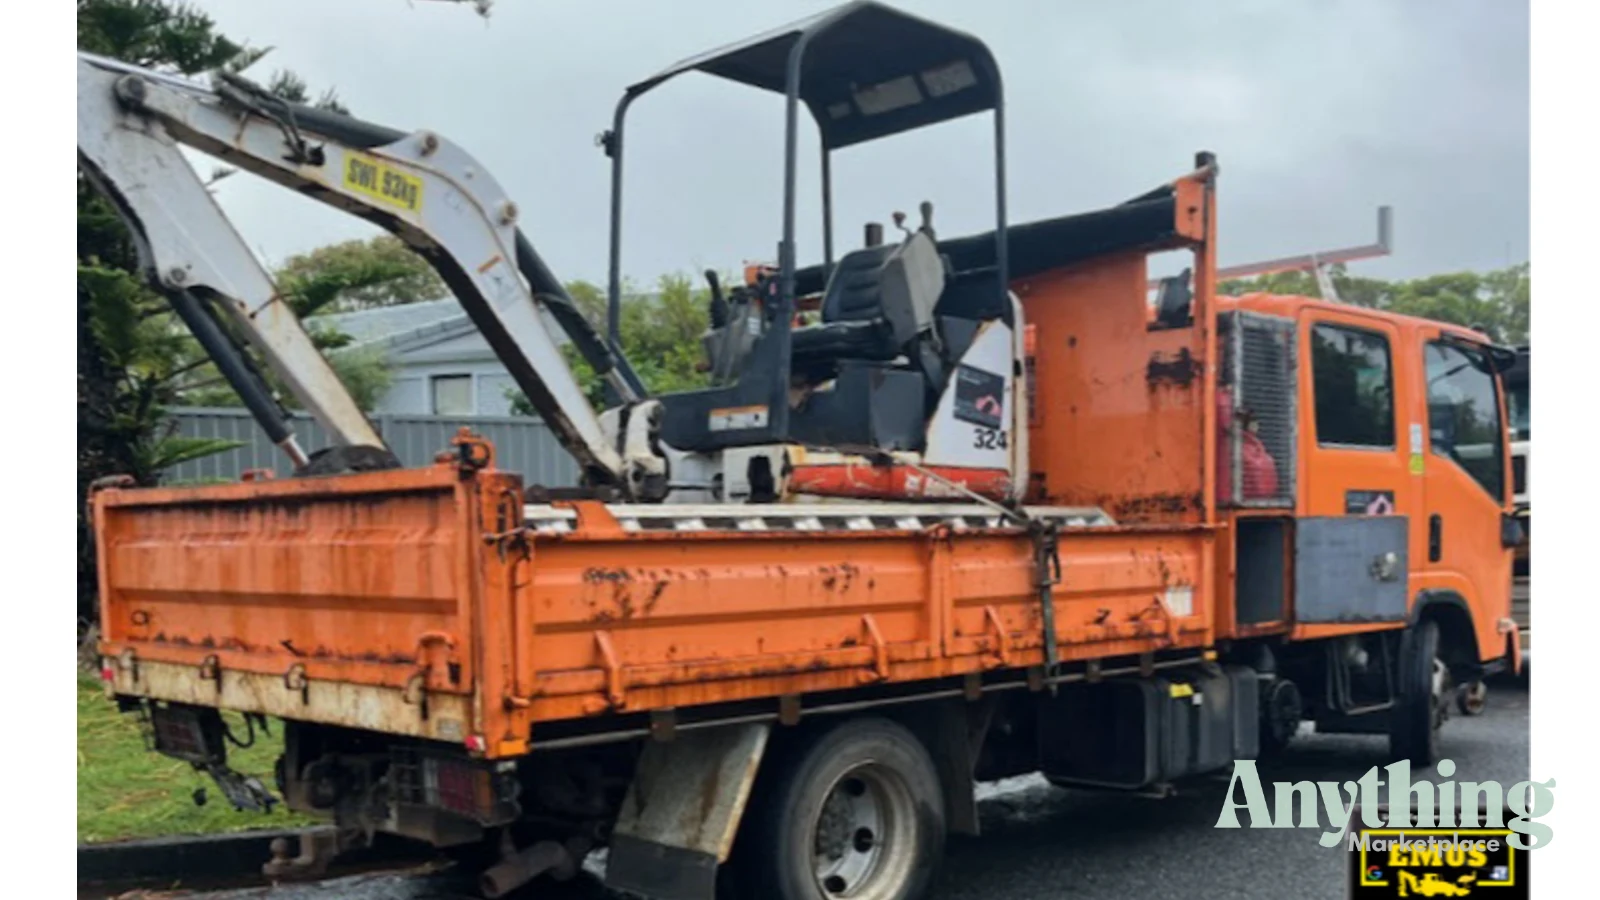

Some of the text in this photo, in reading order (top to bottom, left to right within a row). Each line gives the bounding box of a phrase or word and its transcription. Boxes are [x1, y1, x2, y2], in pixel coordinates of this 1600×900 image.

[348, 158, 418, 210] SWL 93kg
[973, 428, 1008, 450] 324
